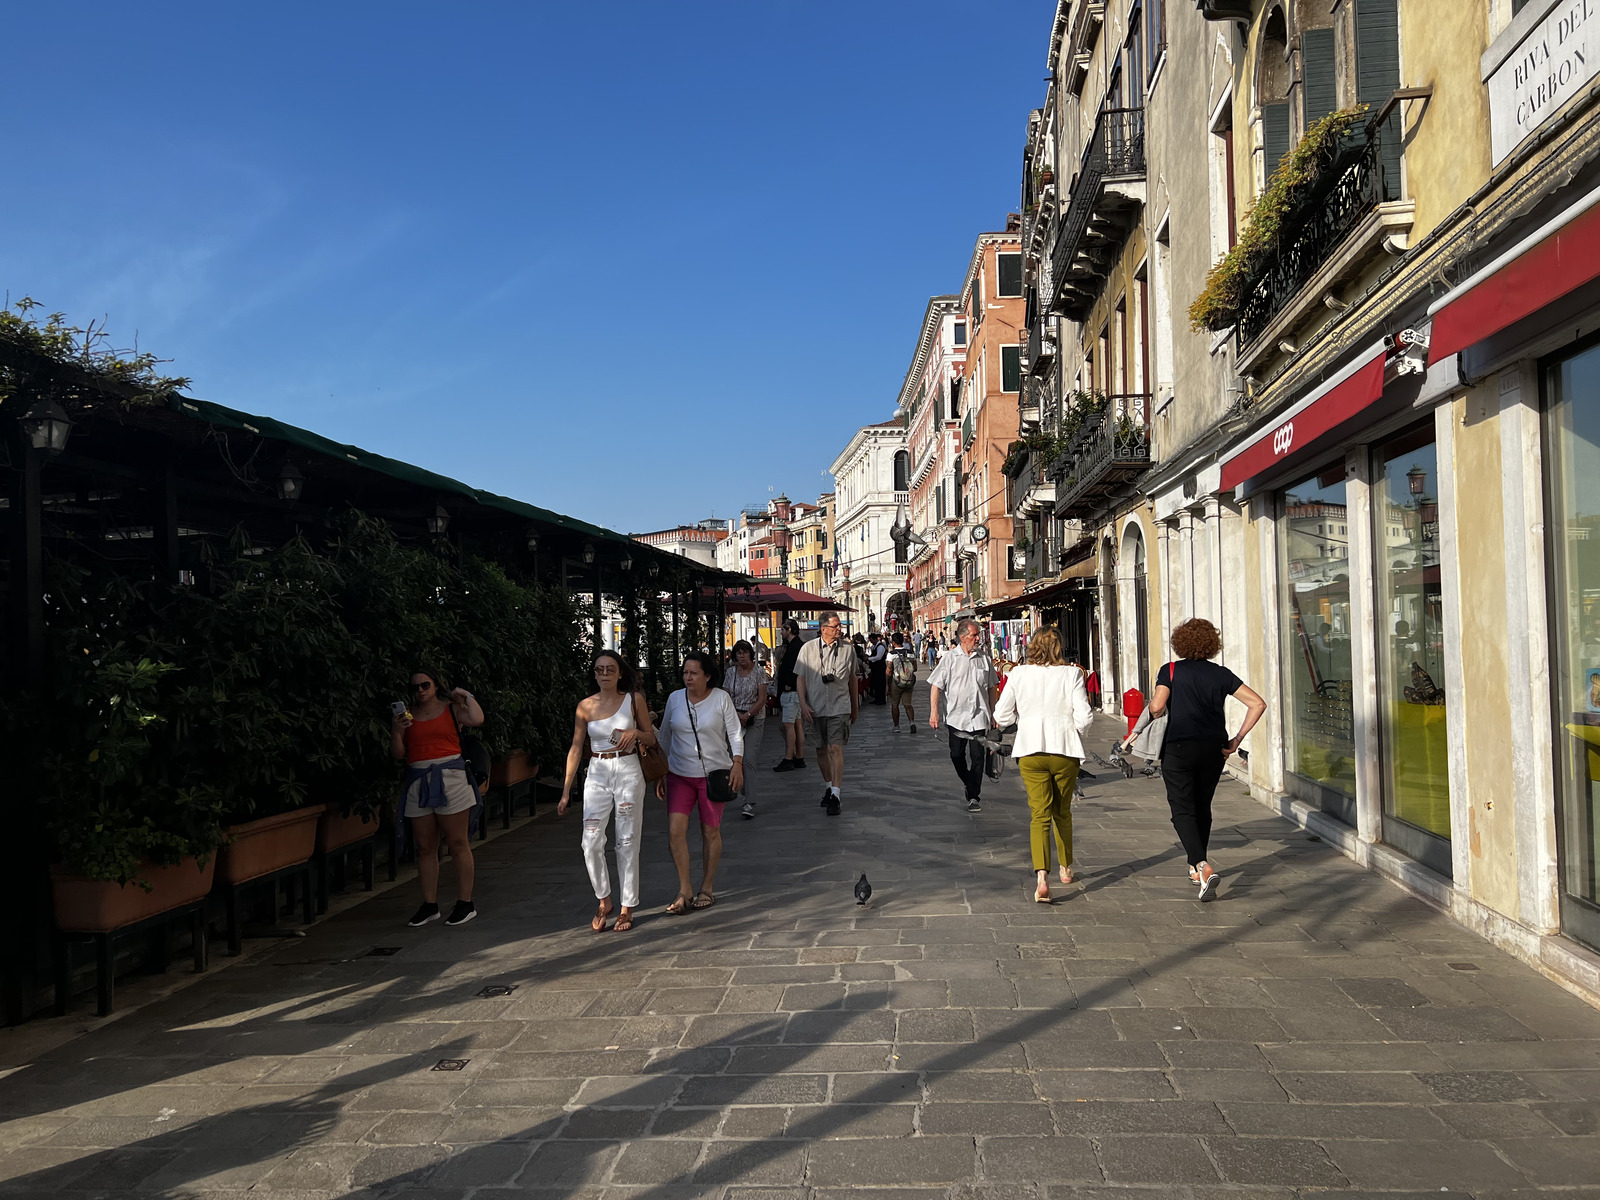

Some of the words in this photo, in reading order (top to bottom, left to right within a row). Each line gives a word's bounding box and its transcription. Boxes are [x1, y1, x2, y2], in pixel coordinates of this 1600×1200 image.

[1514, 40, 1550, 90] RIVA
[1558, 0, 1594, 46] DEL
[1516, 42, 1586, 126] CARBON
[1274, 422, 1294, 455] coop
